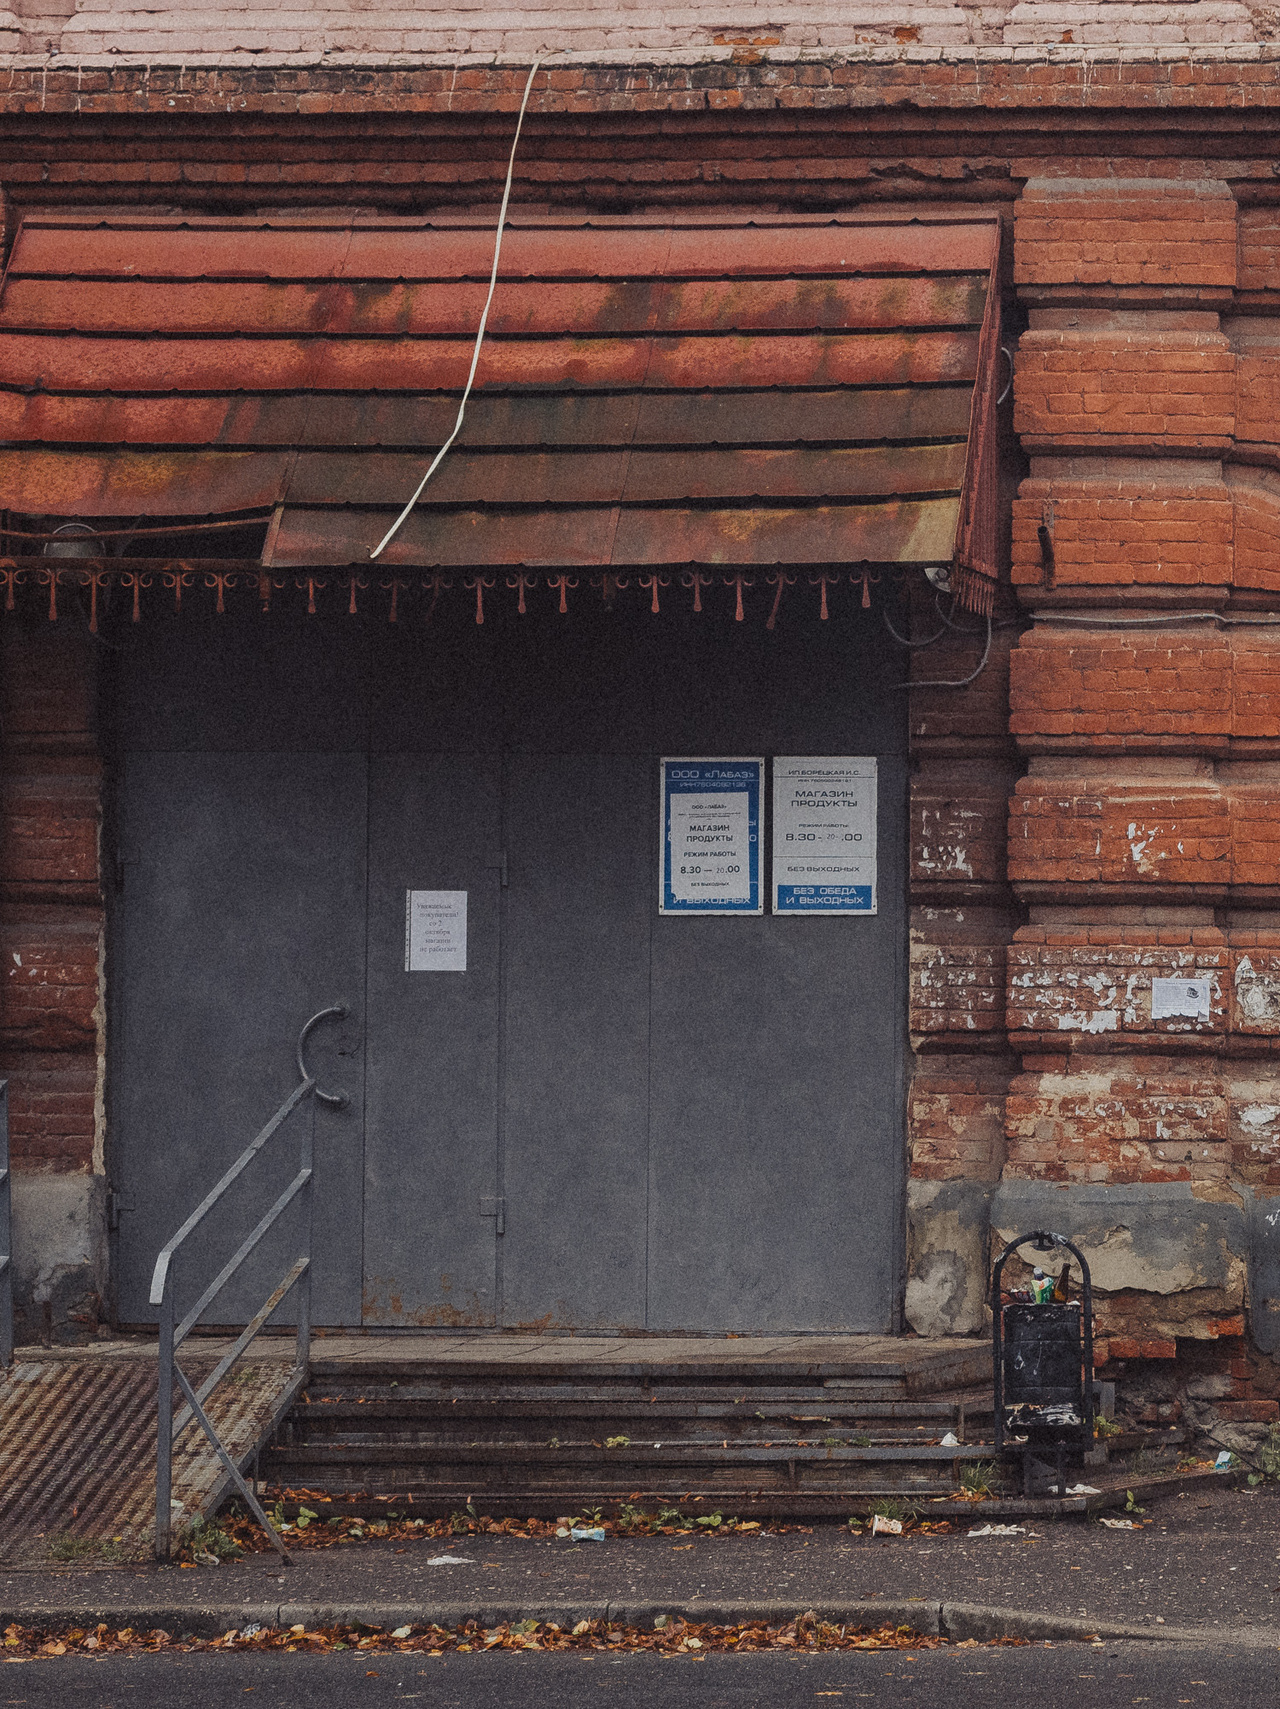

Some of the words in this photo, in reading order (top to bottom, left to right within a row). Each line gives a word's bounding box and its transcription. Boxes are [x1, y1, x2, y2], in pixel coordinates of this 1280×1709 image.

[671, 769, 700, 779] ООО
[795, 790, 854, 798] МАГАЗИН
[791, 799, 858, 808] ПРОДУКТЫ
[689, 824, 730, 832] МАГАЗИН
[686, 835, 733, 843] ПРОДУКТЫ
[785, 833, 816, 841] 8.30
[680, 865, 702, 874] 8.30
[793, 887, 815, 895] БЕЗ
[819, 887, 857, 896] ОБЕДА
[686, 897, 751, 905] ВЫХОДНЫХ
[786, 896, 795, 904] И
[799, 896, 864, 905] ВЫХОДНЫХ
